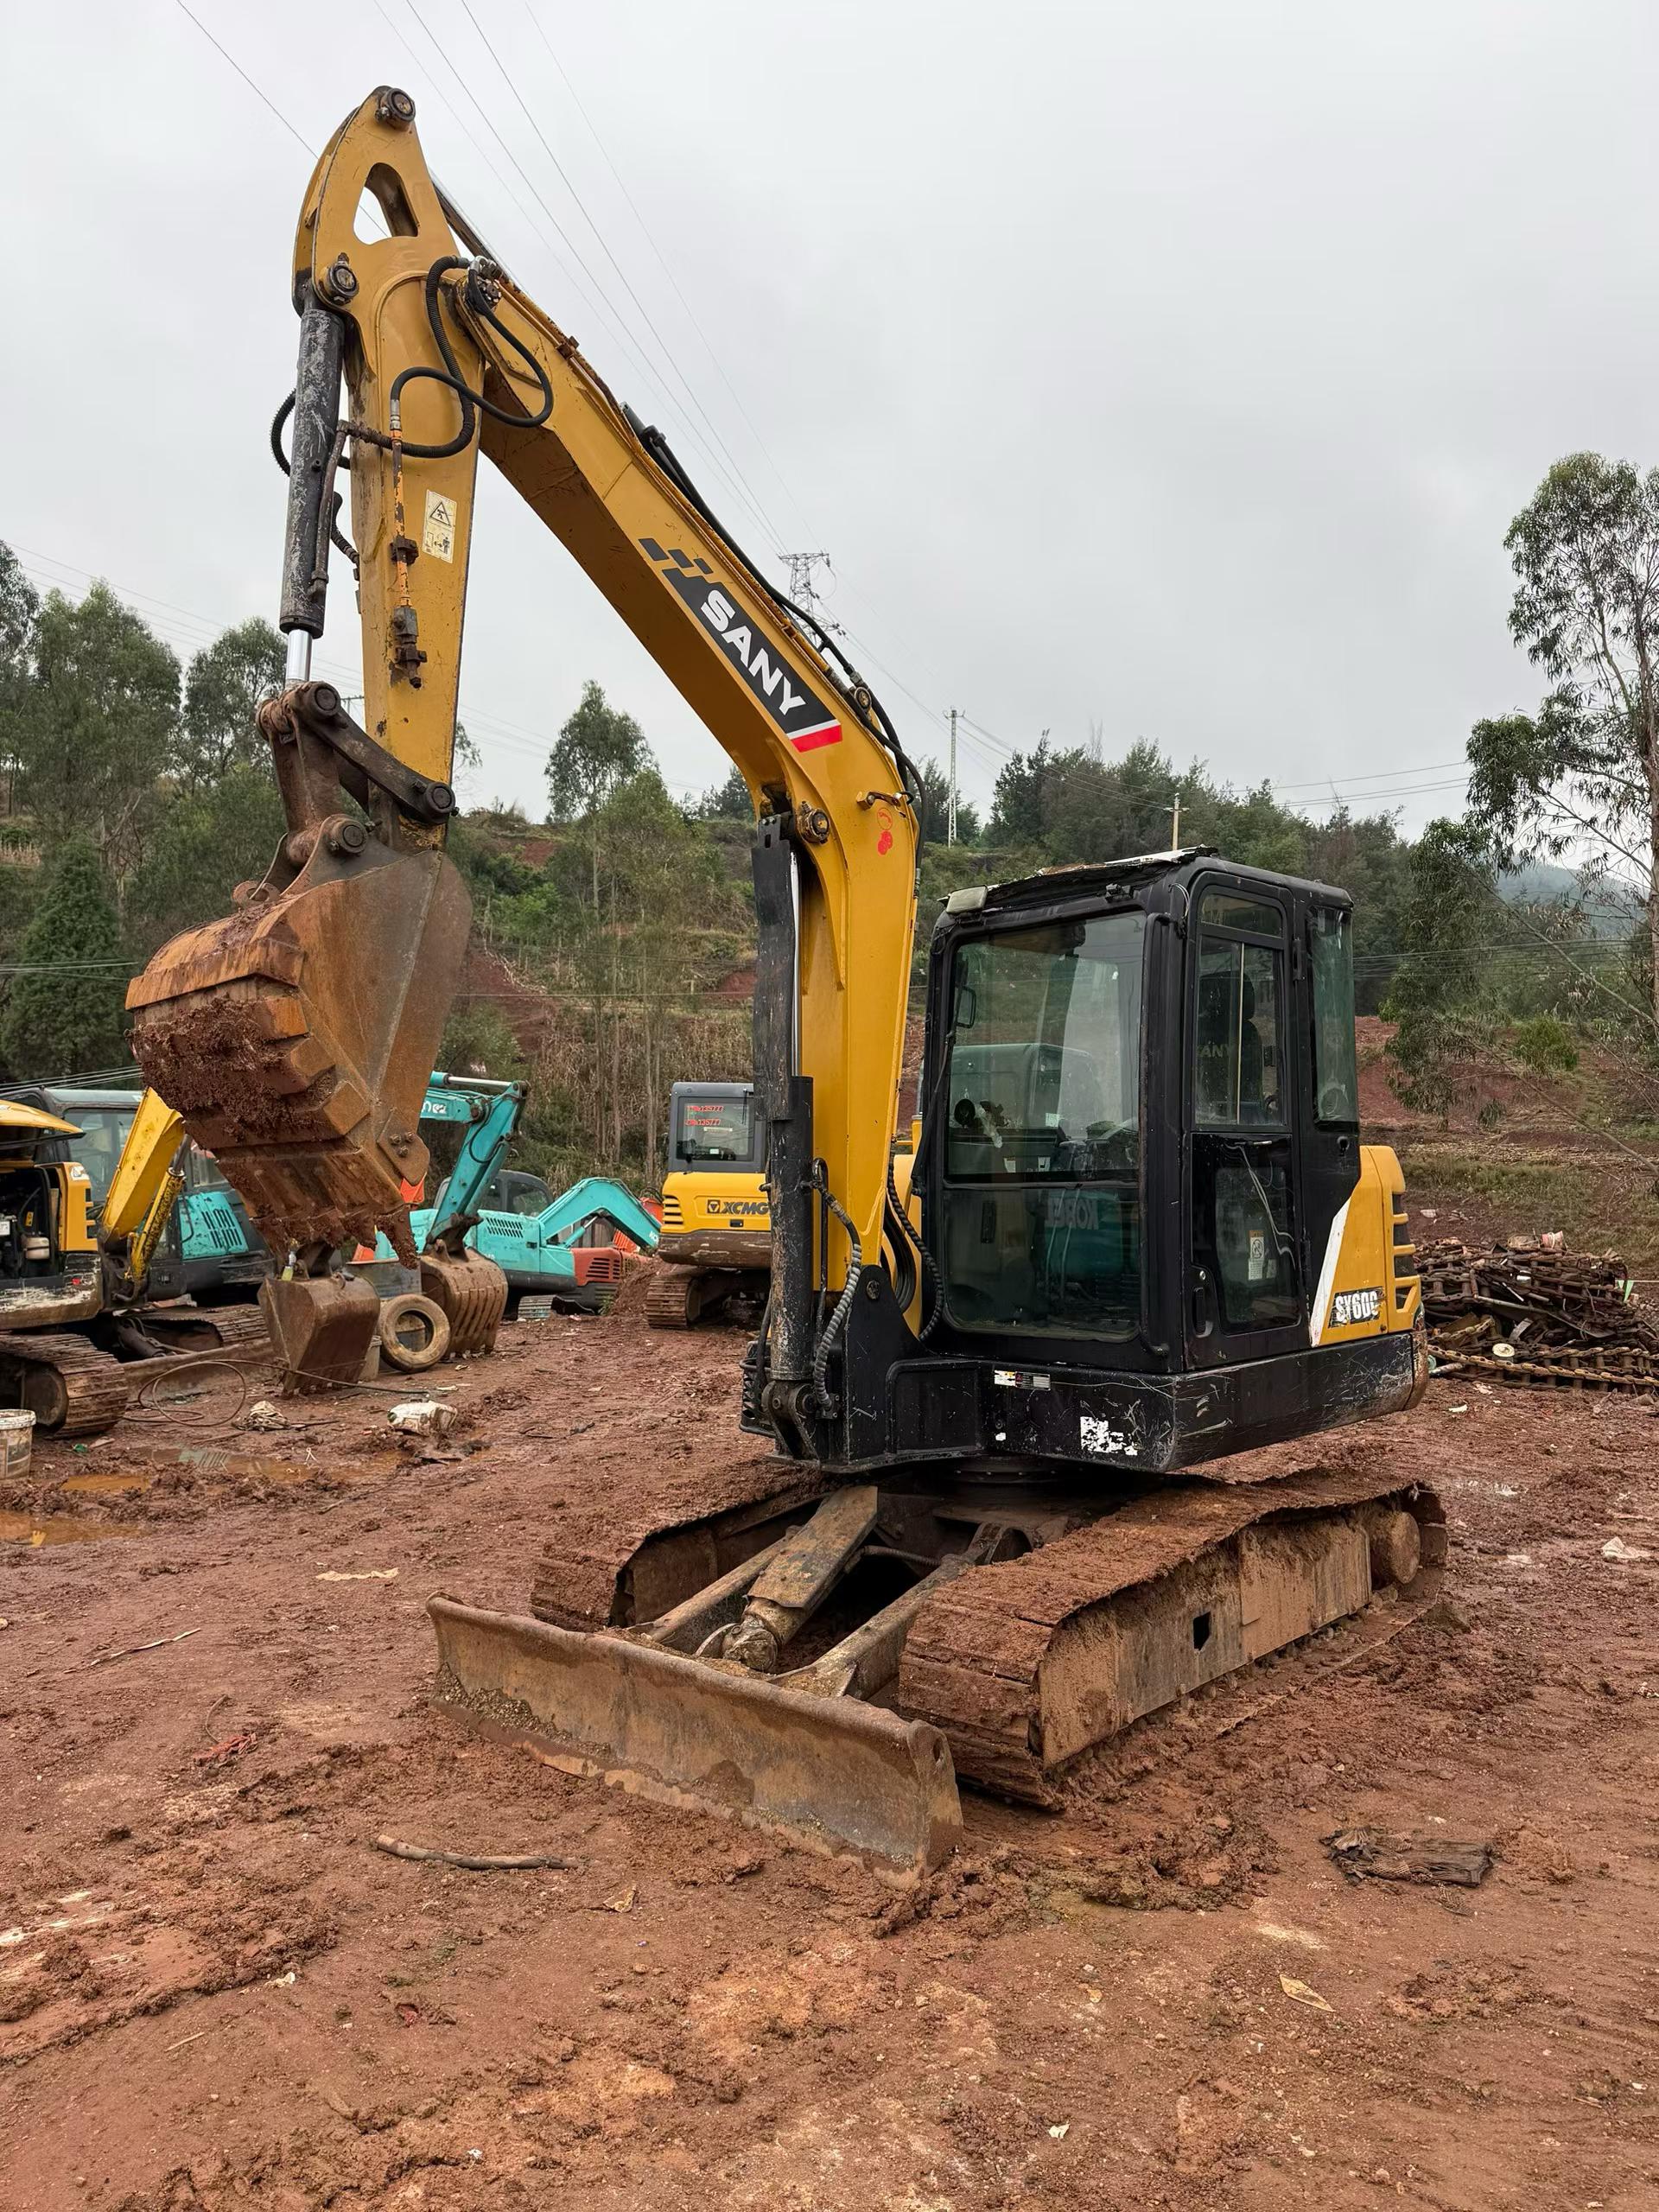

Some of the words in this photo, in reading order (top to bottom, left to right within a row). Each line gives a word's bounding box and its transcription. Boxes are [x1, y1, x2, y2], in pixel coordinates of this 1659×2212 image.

[701, 589, 806, 715] SANY
[721, 1201, 769, 1215] XCMG
[1335, 1291, 1379, 1324] SY60C
